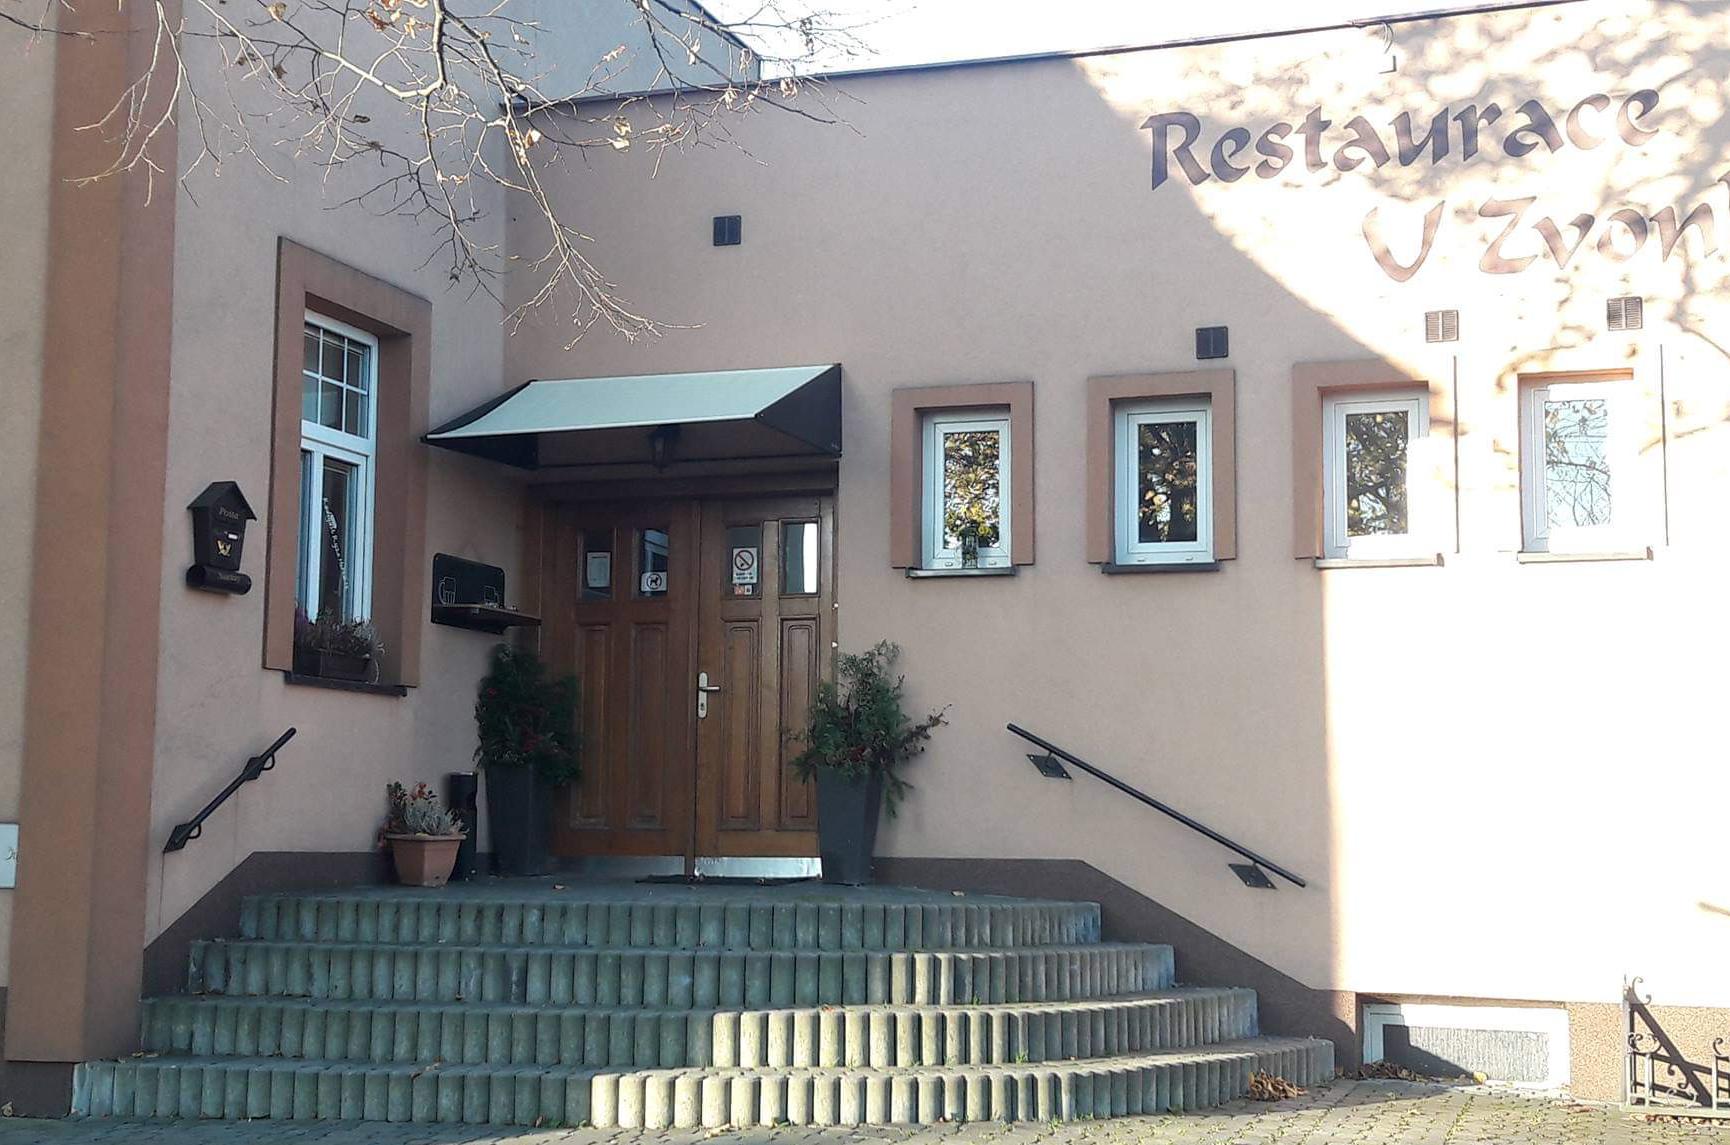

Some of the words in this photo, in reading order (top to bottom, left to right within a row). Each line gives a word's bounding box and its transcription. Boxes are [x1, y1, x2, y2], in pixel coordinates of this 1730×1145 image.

[1139, 88, 1660, 191] Restaurace
[1362, 199, 1446, 283] U
[1478, 169, 1730, 275] Zvon
